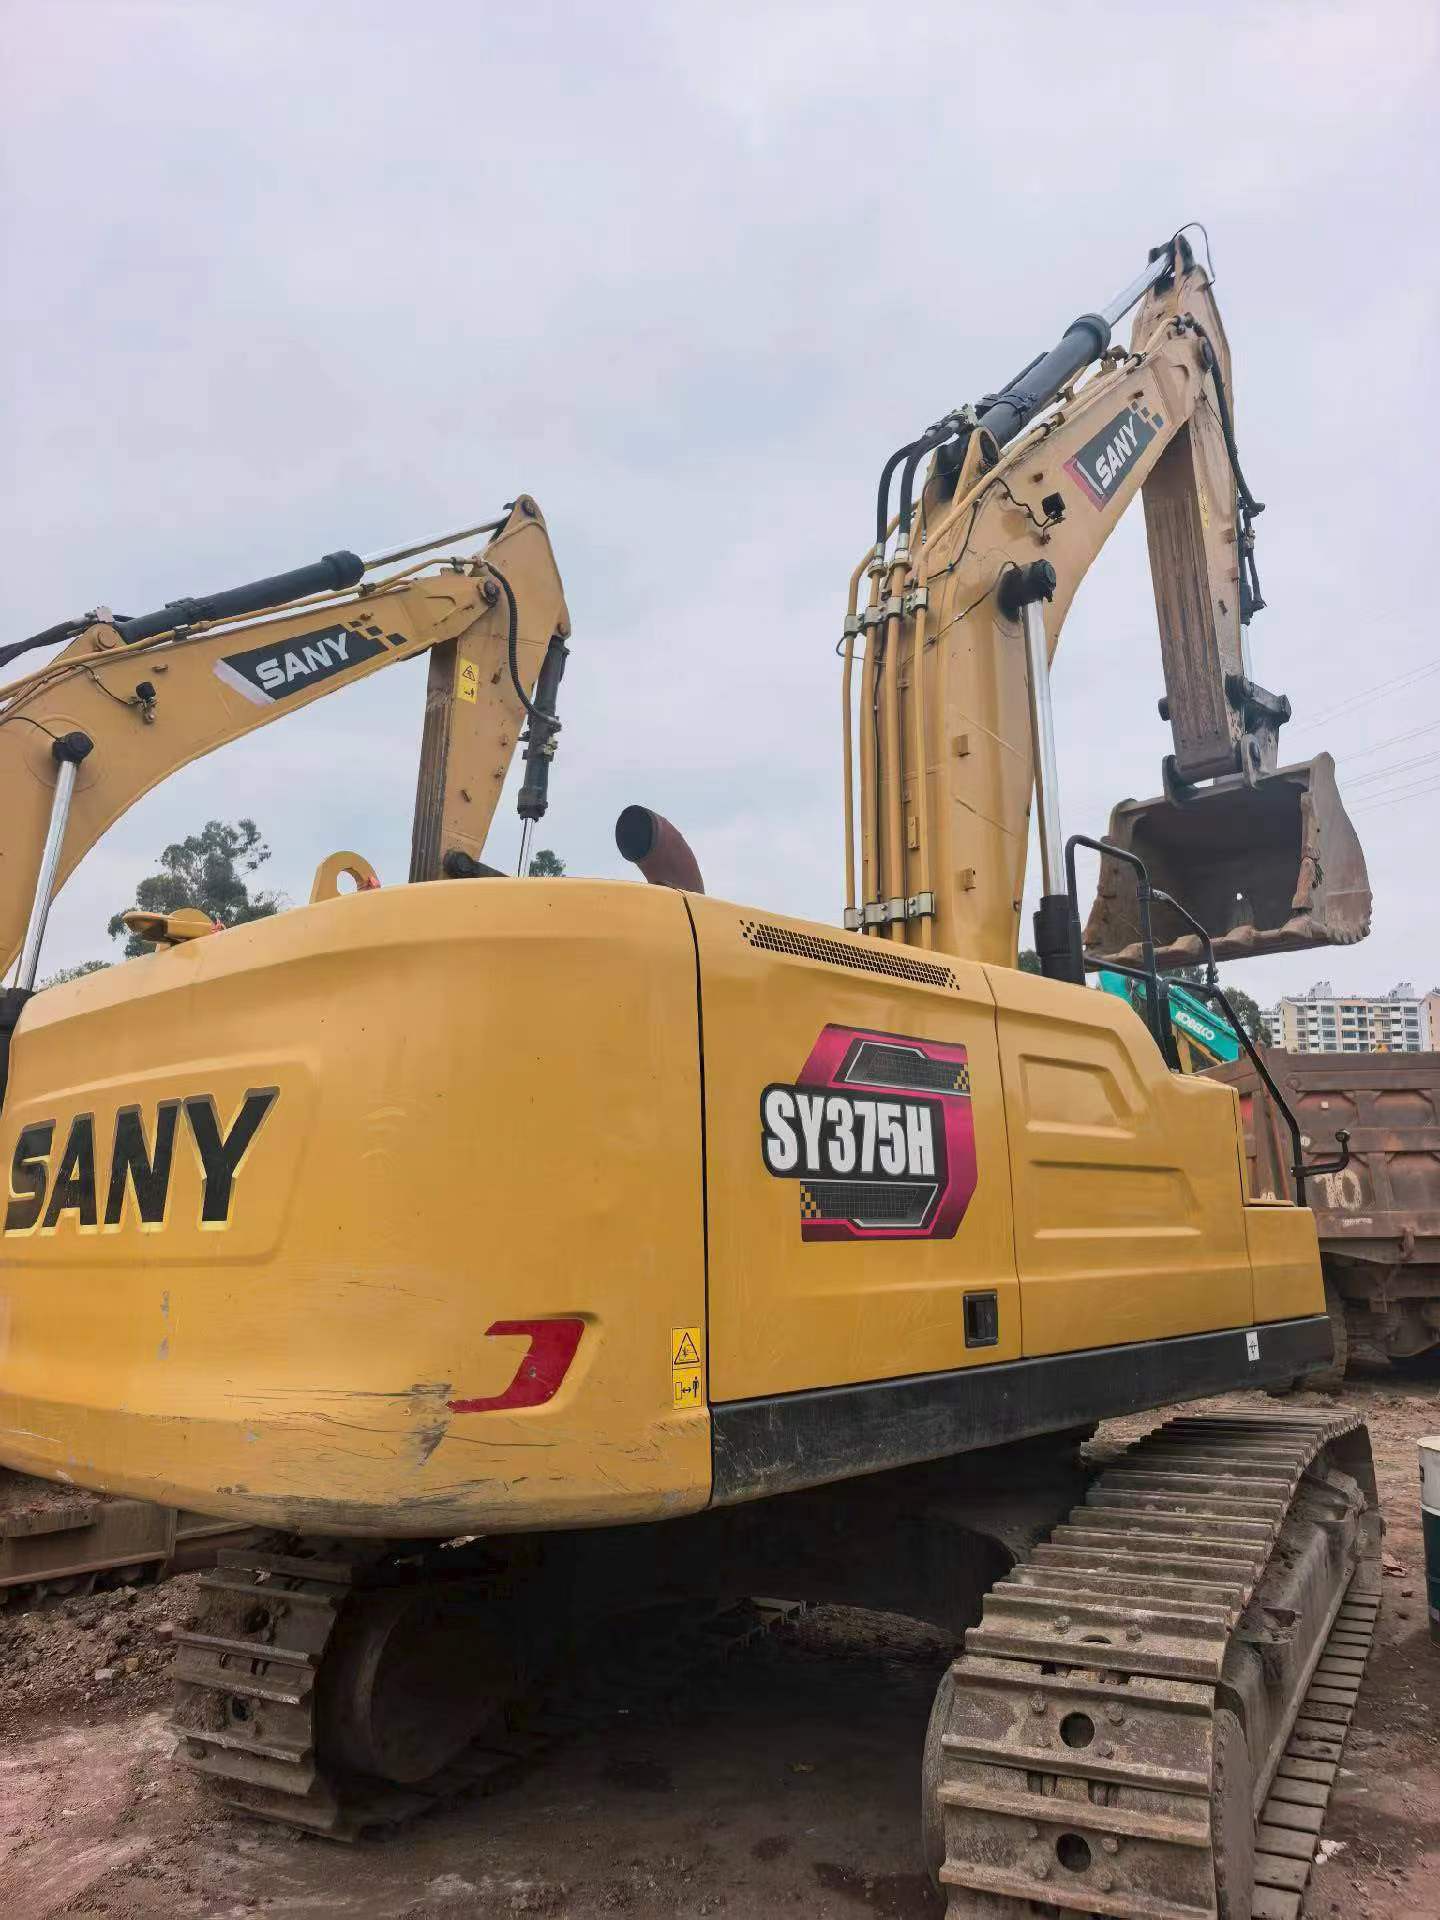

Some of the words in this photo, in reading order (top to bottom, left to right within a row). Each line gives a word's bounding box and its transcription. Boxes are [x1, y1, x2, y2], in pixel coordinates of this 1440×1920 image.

[1095, 415, 1138, 489] SANY
[255, 632, 350, 691] SANY
[1175, 1010, 1215, 1041] KOBELCO
[4, 1085, 280, 1237] SANY
[764, 1089, 936, 1176] SY375H
